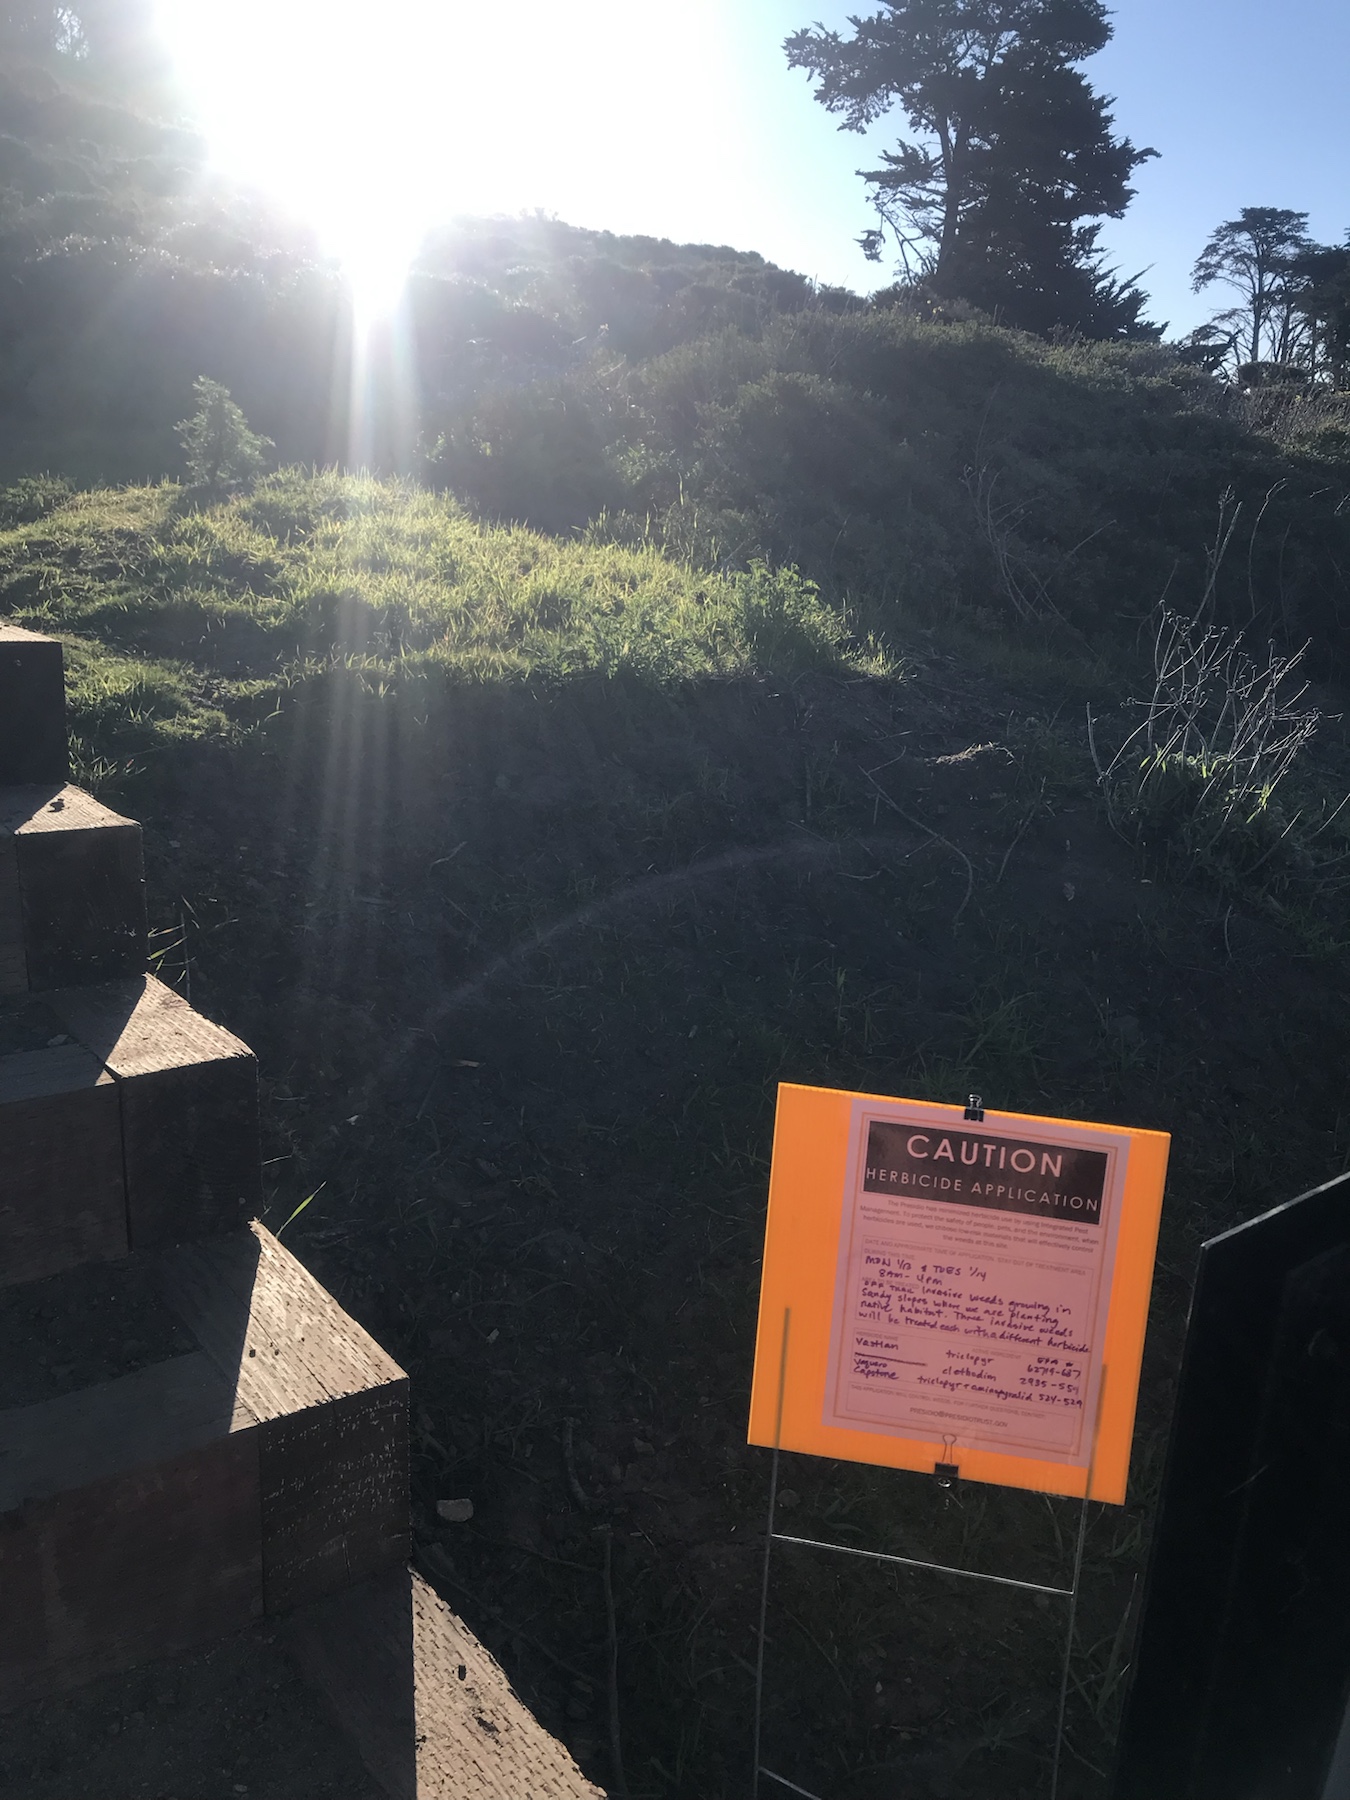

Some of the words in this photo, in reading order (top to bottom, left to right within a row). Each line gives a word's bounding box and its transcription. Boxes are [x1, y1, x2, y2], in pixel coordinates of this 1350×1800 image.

[906, 1134, 1063, 1178] CAUTION
[866, 1166, 962, 1192] HERBICIDE
[971, 1182, 1099, 1212] APPLICATION
[911, 1212, 933, 1221] protect
[971, 1212, 1000, 1220] herbicide
[1014, 1217, 1022, 1225] by
[1023, 1220, 1040, 1229] using
[1041, 1222, 1073, 1232] Integrated
[858, 1310, 881, 1320] will
[888, 1312, 900, 1325] be
[1056, 1304, 1072, 1316] in
